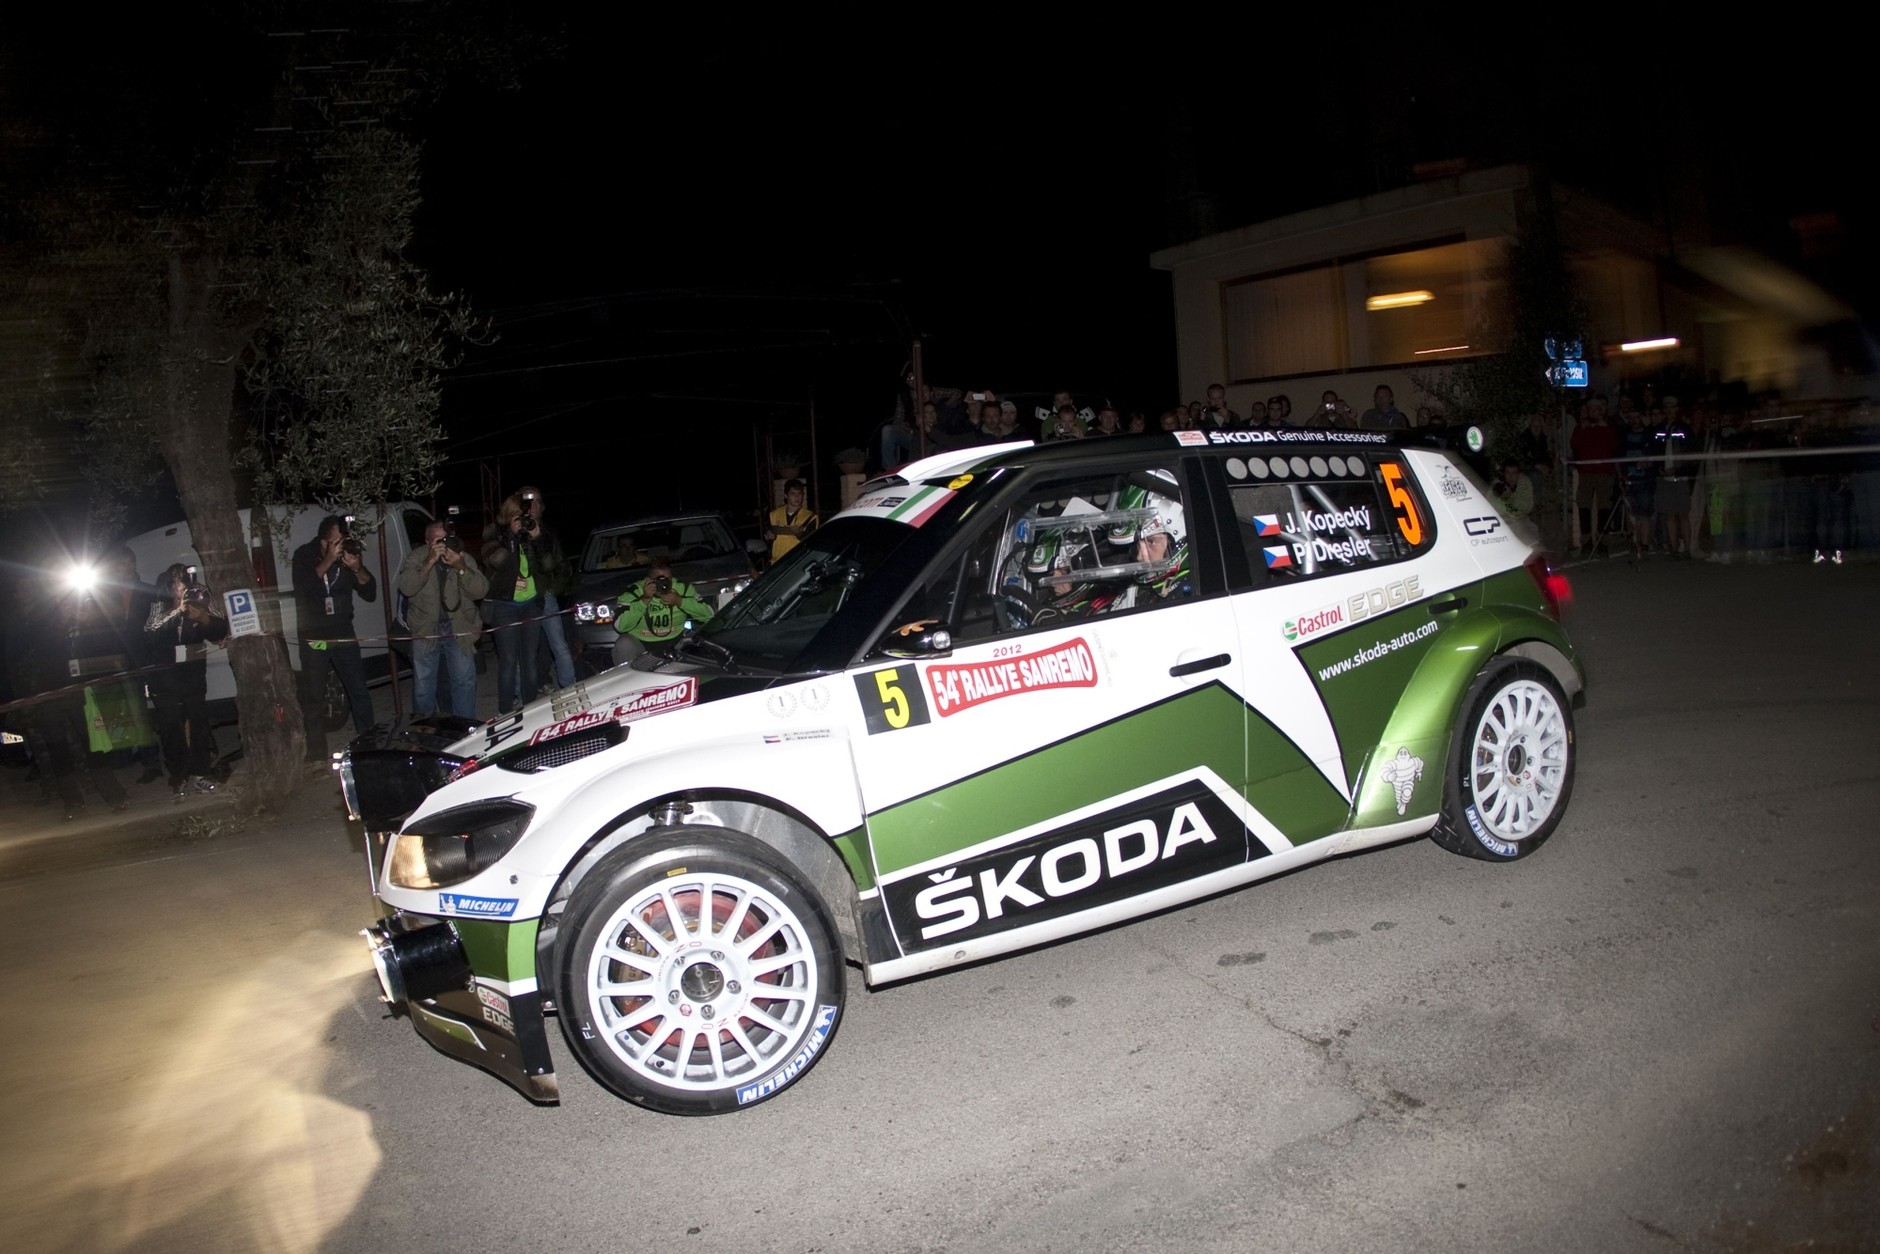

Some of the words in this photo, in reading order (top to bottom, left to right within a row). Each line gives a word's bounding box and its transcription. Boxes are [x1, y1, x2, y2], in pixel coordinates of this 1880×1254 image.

[1209, 430, 1277, 445] ŠKODA
[1277, 430, 1326, 443] Genuine
[1285, 510, 1302, 534] J.
[1304, 505, 1372, 535] Kopecký
[1379, 463, 1421, 546] 5
[1314, 537, 1372, 562] Dresler
[232, 594, 246, 613] P
[1297, 605, 1344, 636] Castrol
[1347, 574, 1425, 623] EDGE
[961, 663, 1017, 702] RALLYE
[1022, 643, 1094, 688] SANREMO
[992, 644, 1023, 658] 2012
[1318, 620, 1439, 682] www.skoda-auto.com
[564, 705, 618, 733] RALLYE
[620, 683, 688, 714] SANREMO
[874, 668, 910, 730] 5
[1467, 809, 1507, 855] MICHELIN
[915, 801, 1217, 941] ŠKODA
[458, 898, 515, 913] MICHELIN
[482, 1006, 517, 1036] EDGE
[741, 1029, 826, 1103] MICHELIN
